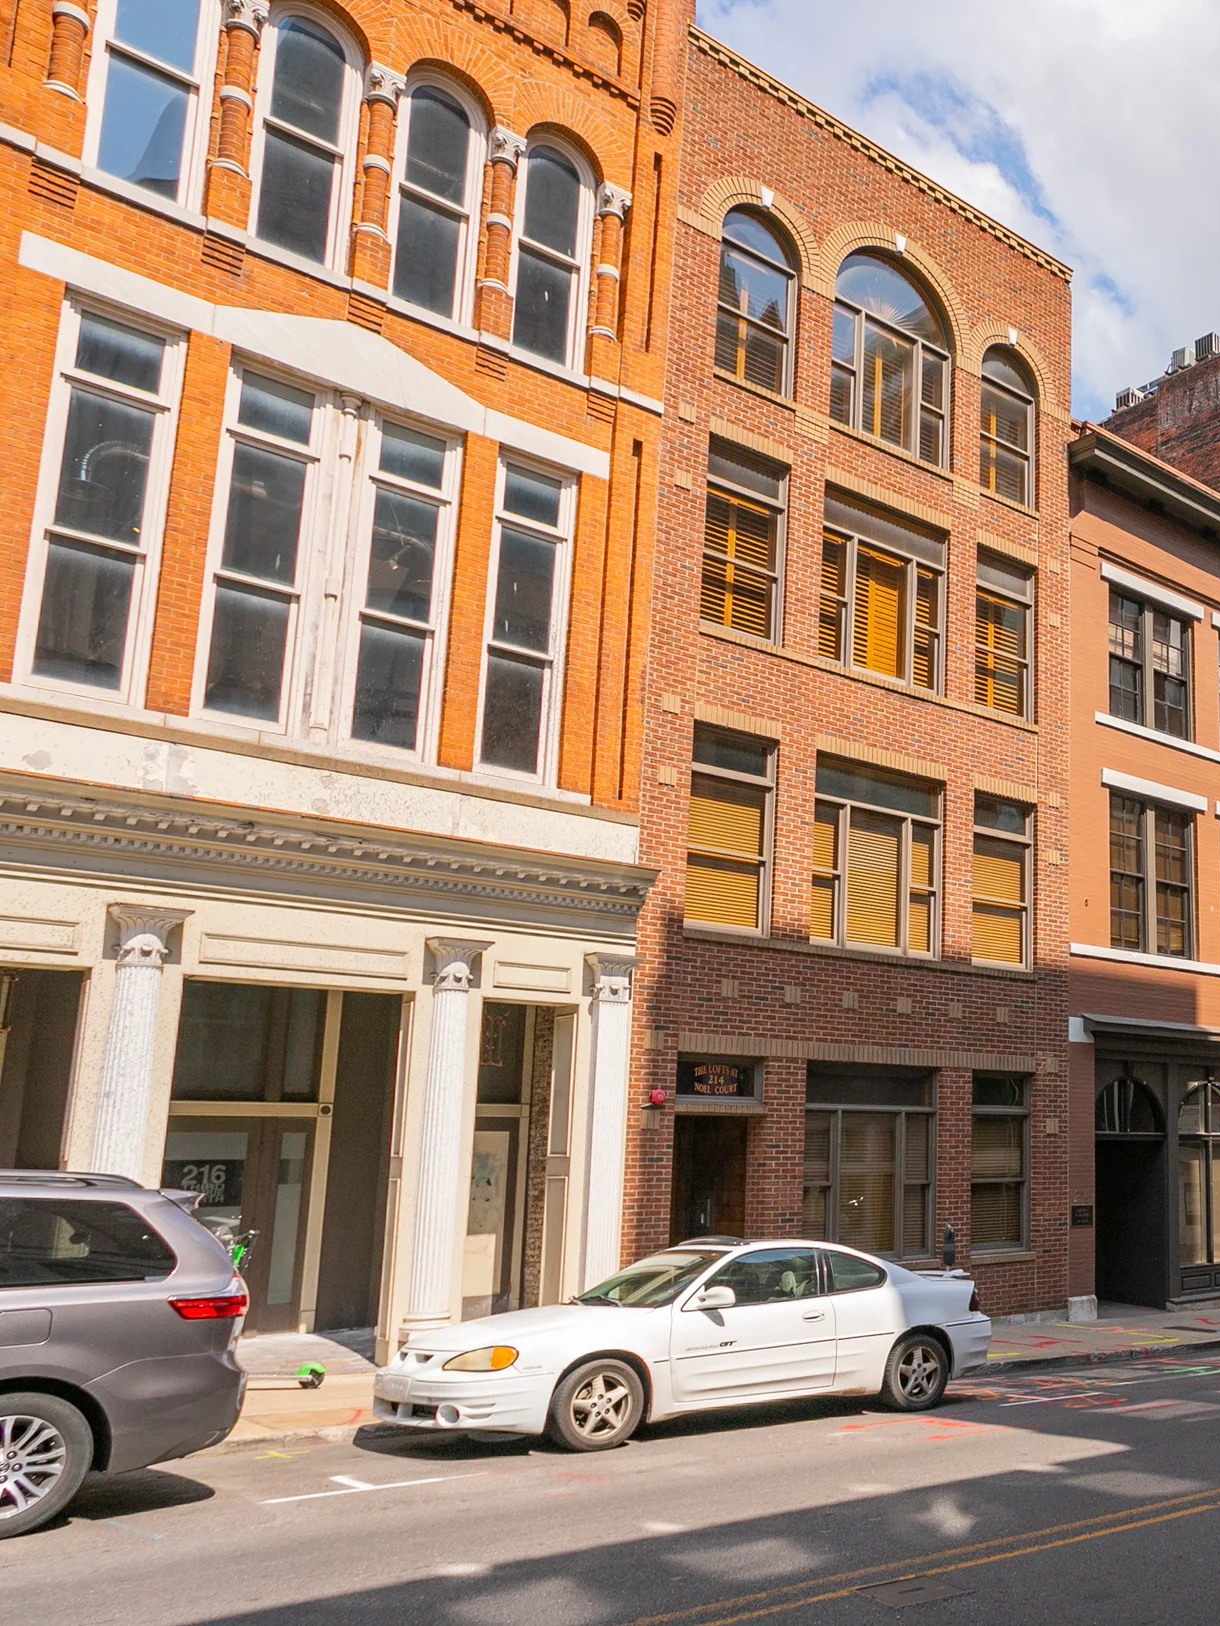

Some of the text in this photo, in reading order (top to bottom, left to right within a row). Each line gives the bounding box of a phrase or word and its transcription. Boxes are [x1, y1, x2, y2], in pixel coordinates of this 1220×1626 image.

[694, 1064, 739, 1078] THE LOFTS AT
[708, 1075, 724, 1085] 214
[694, 1082, 738, 1094] NOEL COURT
[181, 1164, 226, 1186] 216
[719, 1340, 737, 1348] GT
